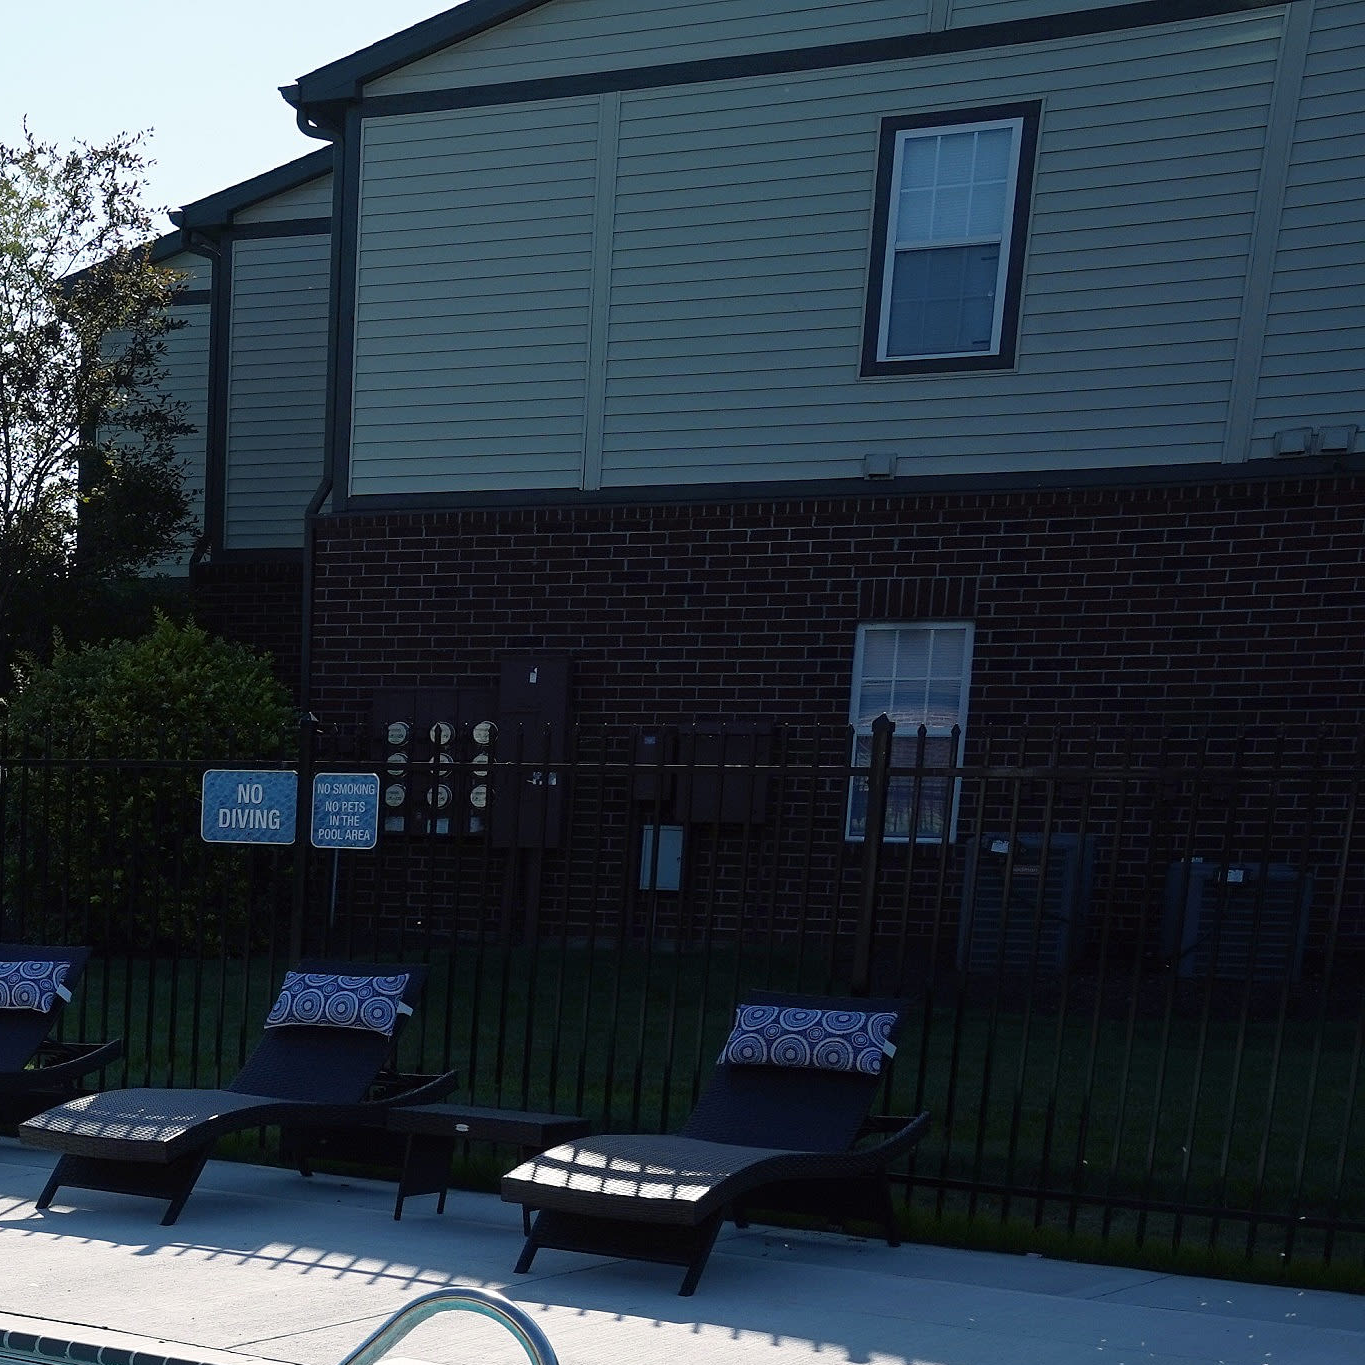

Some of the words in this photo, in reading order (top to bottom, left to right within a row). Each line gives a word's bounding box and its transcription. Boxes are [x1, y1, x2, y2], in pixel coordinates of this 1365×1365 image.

[237, 783, 263, 804] NO
[317, 783, 331, 794] NO
[332, 783, 376, 795] SMOKING
[325, 801, 340, 813] NO
[341, 801, 366, 813] PETS
[218, 808, 281, 830] DIVING
[329, 815, 340, 826] IN
[341, 815, 360, 827] THE
[318, 828, 343, 840] POOL
[344, 829, 371, 841] AREA
